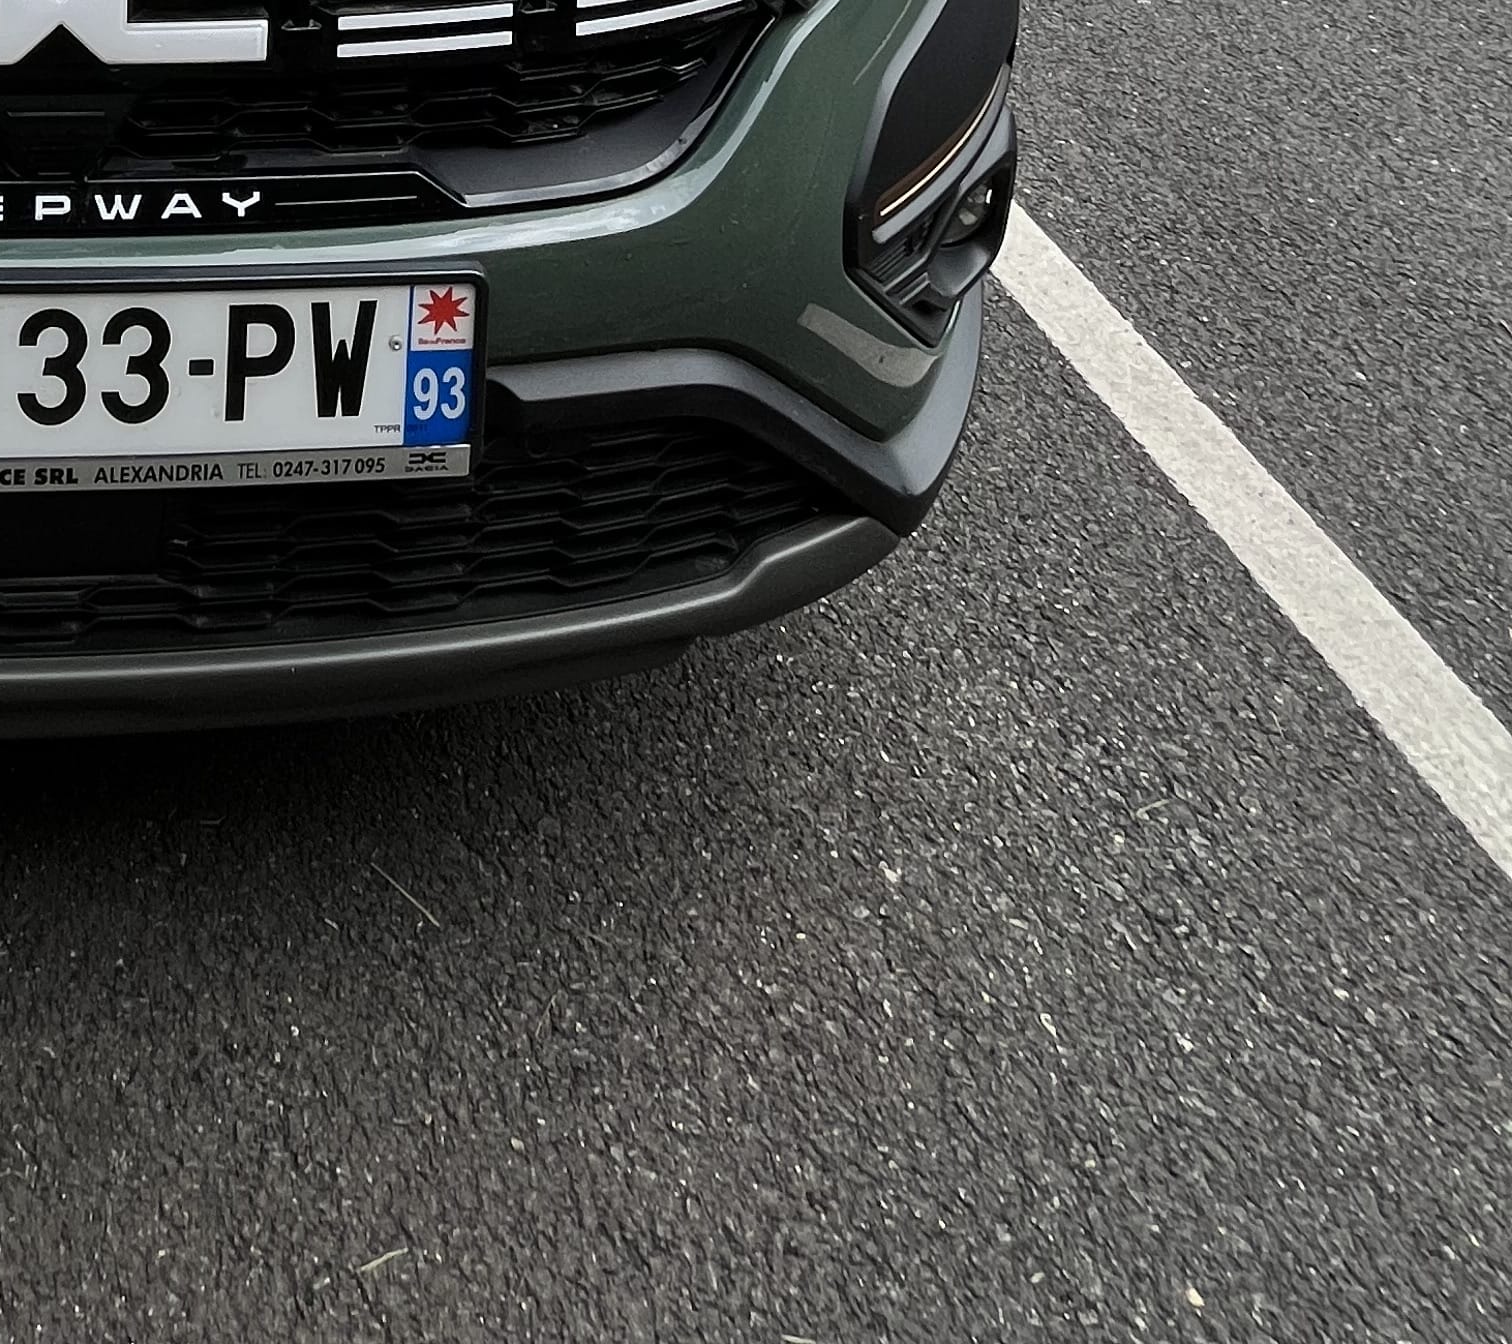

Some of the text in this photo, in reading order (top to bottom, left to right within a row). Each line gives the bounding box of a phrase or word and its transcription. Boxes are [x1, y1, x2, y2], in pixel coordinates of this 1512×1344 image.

[413, 366, 467, 421] 93
[34, 467, 79, 486] SRL
[93, 462, 224, 484] ALEXANDRIA
